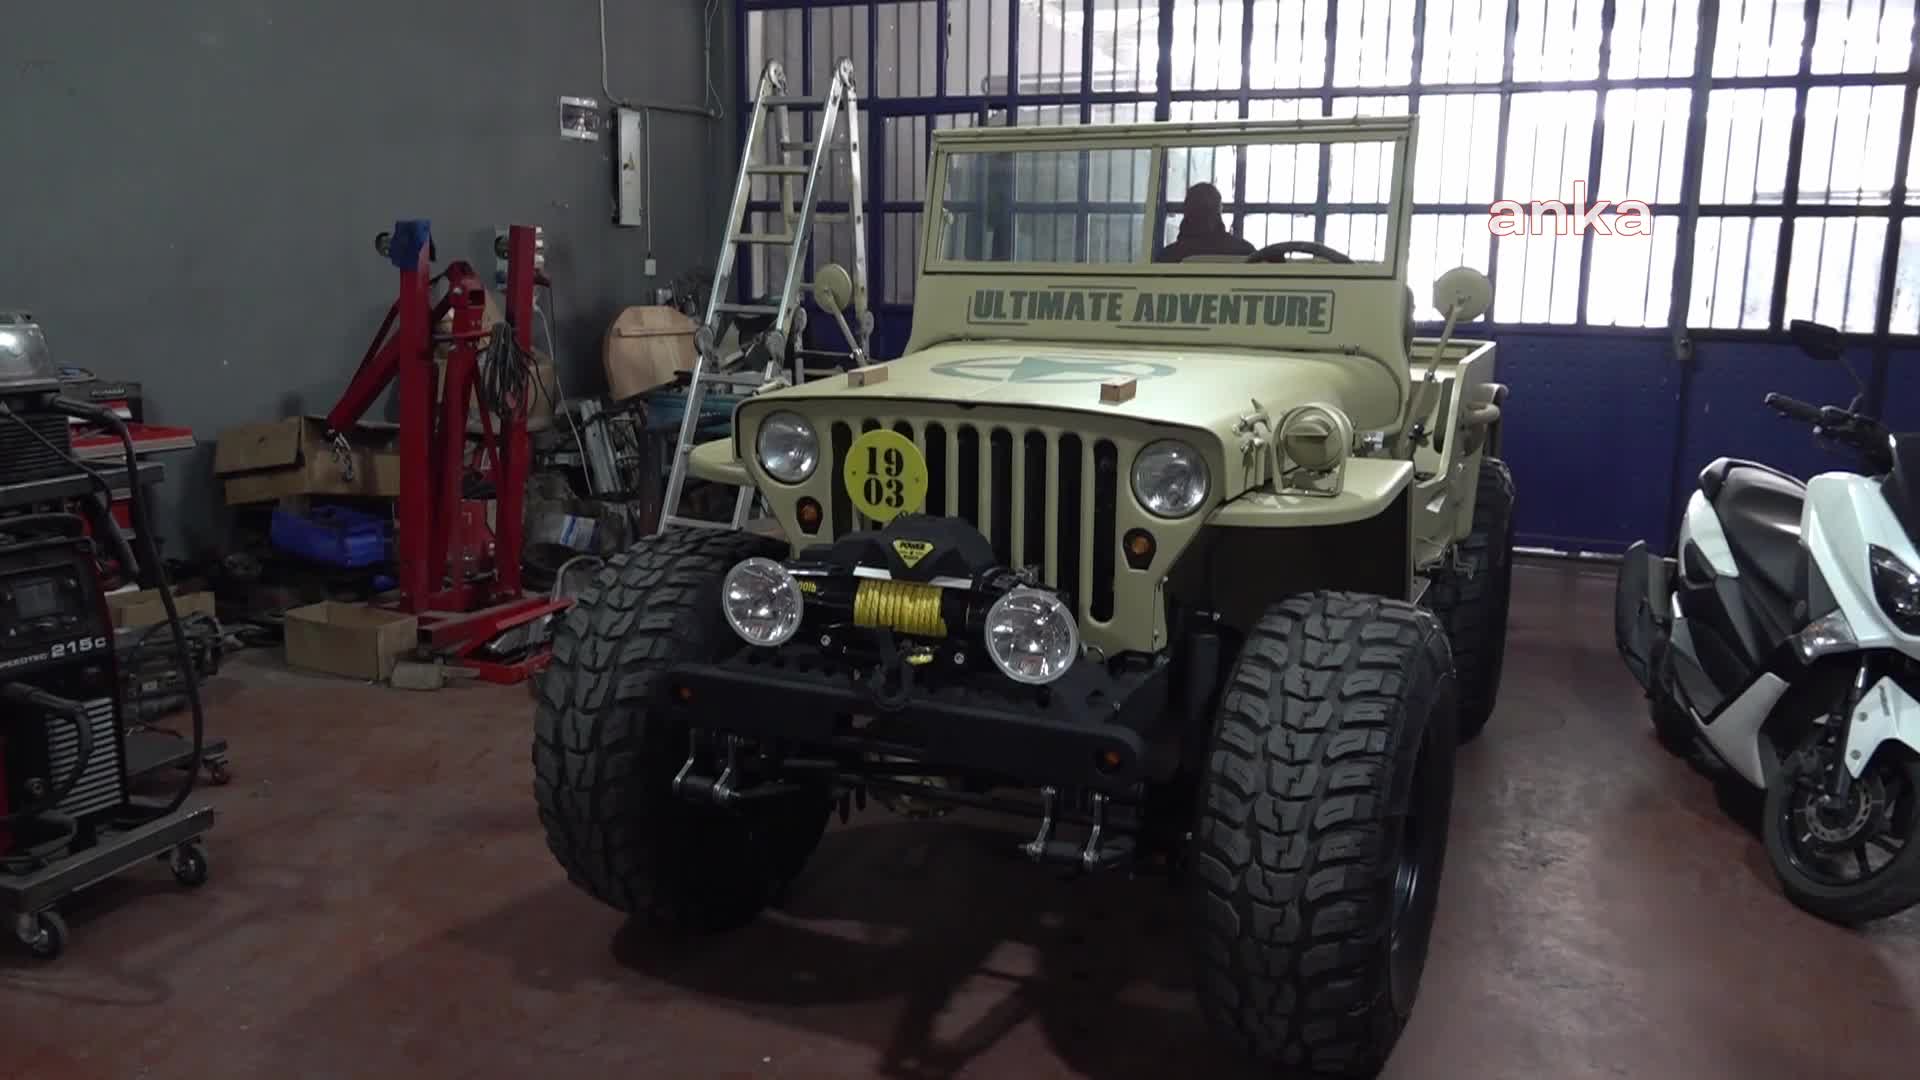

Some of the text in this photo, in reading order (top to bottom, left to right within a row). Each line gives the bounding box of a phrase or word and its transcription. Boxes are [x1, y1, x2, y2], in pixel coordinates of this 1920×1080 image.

[973, 289, 1327, 328] ULTIMATE ADVENTURE
[866, 446, 904, 478] 19
[863, 477, 905, 508] 03
